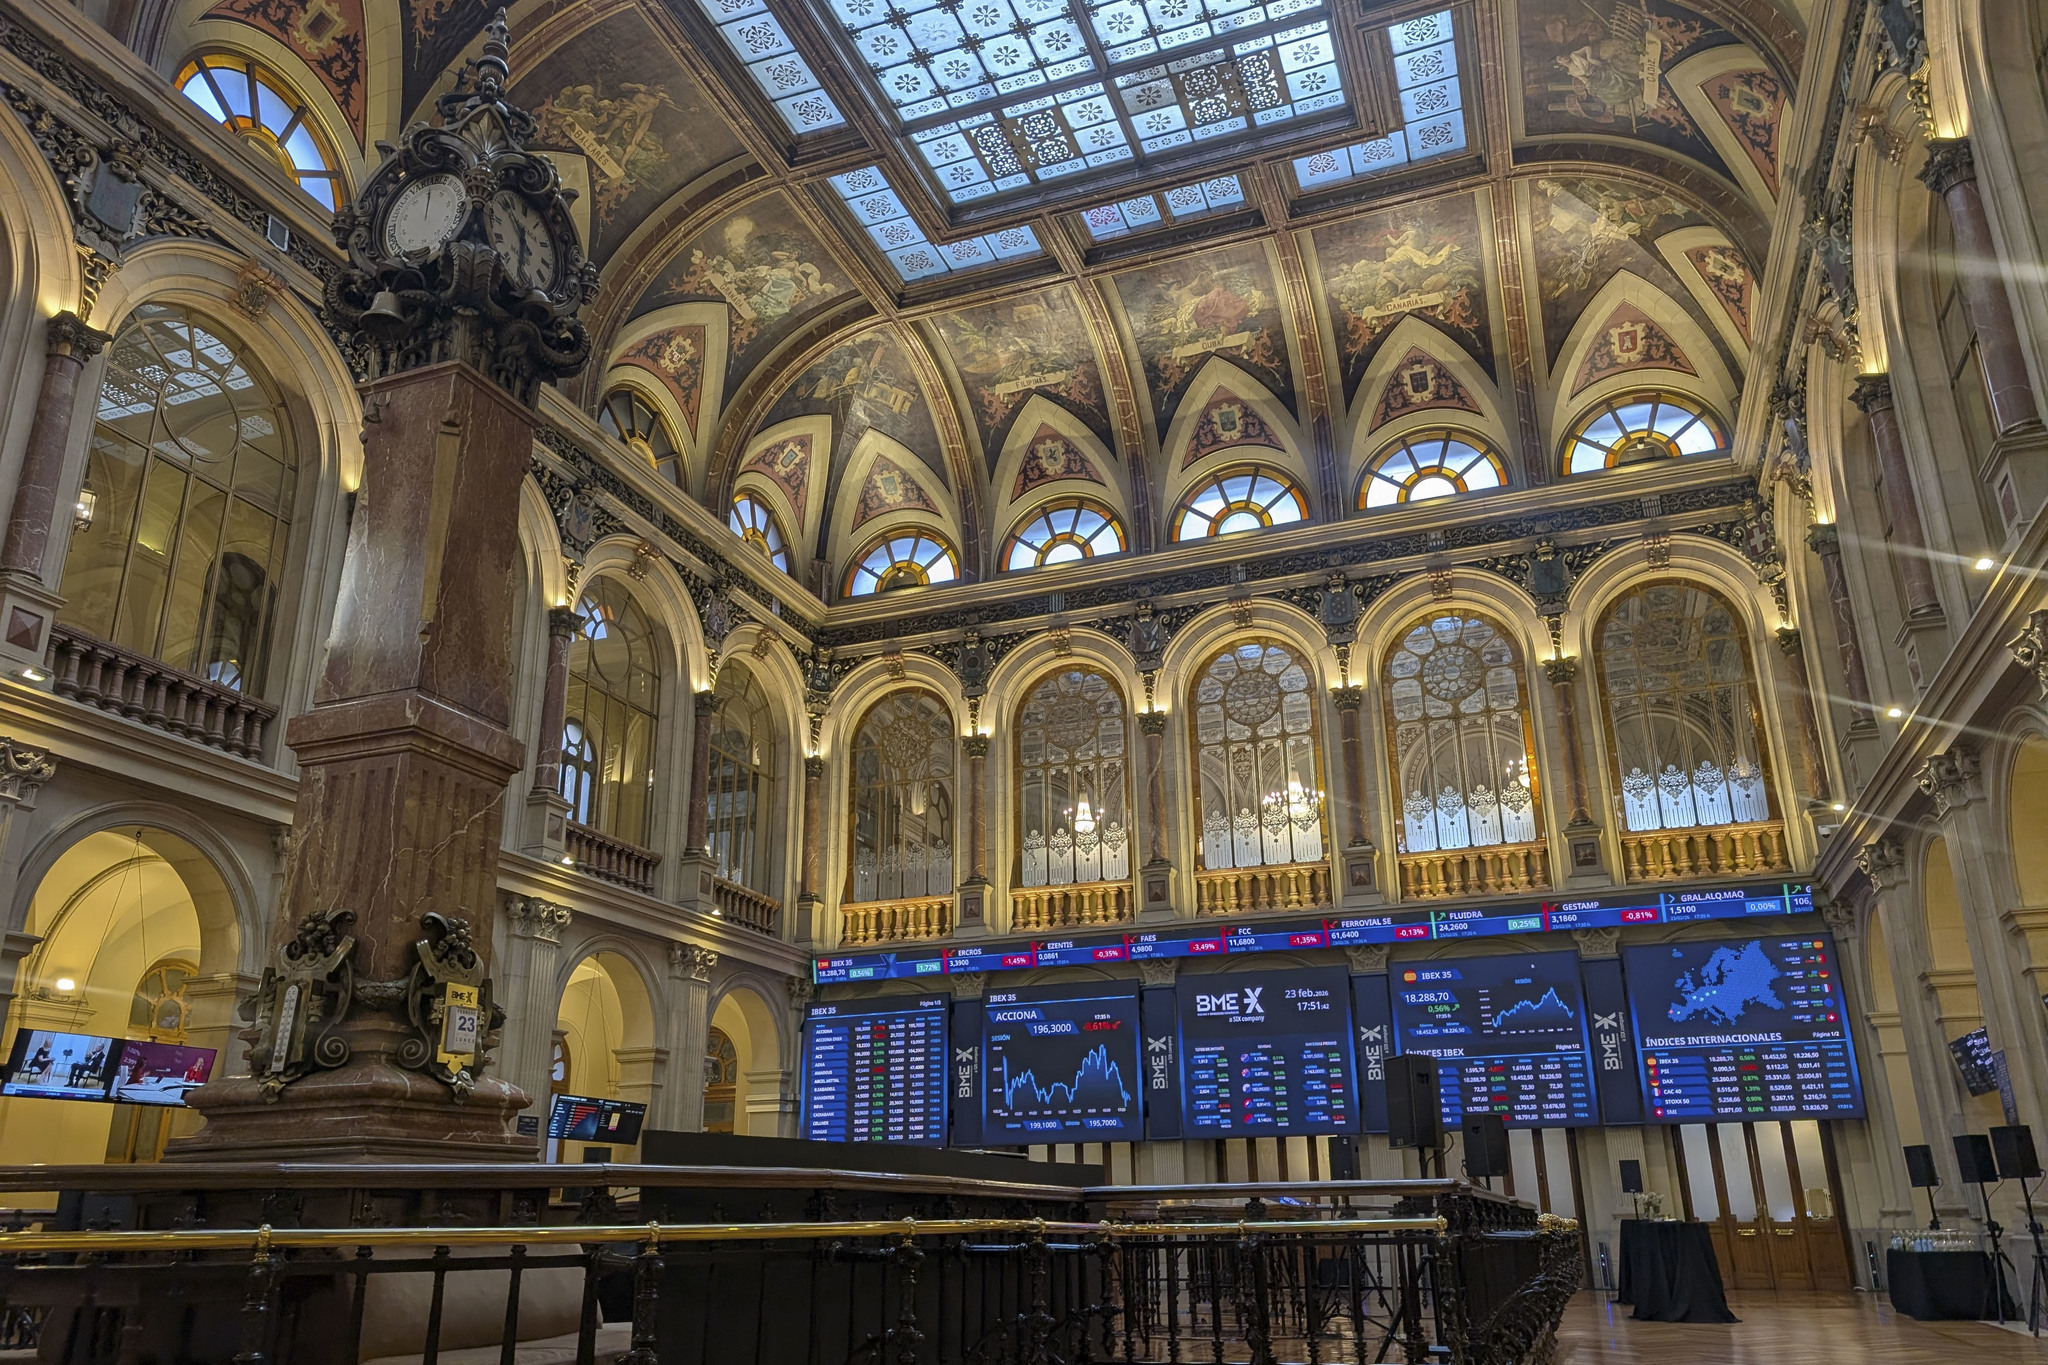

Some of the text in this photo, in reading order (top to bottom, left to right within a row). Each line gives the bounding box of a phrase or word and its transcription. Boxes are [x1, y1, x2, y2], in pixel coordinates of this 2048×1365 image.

[574, 131, 608, 165] BALEARES
[410, 176, 449, 195] VARIABLE
[1681, 891, 1744, 902] GRAL.ALQ.MAQ
[1563, 902, 1599, 911] GESTAMP
[1669, 902, 1775, 914] 1,5100 0,00%
[1449, 910, 1483, 920] FLUIDRA
[1551, 911, 1653, 923] 3,1860 -0,81%
[1341, 917, 1392, 928] FERROVIAL SE
[1439, 920, 1535, 932] 24,2600 0,25%
[1331, 928, 1424, 939] 61,6400 -0,13%
[1047, 941, 1073, 949] EZENTIS
[1229, 936, 1317, 946] 11,6800 -1,35%
[1131, 943, 1215, 953] 4,9800 -3,49%
[1038, 950, 1118, 961] 0,0861 -0,35%
[949, 957, 1026, 967] 3,3900 -1,45%
[1421, 971, 1452, 980] IBEX 35
[1285, 990, 1296, 998] 23
[1405, 992, 1449, 1003] 18.288,70
[1196, 993, 1239, 1012] BME
[811, 1007, 827, 1015] IBEX
[1428, 1005, 1450, 1013] 0,56%
[996, 1011, 1037, 1021] ACCIONA
[1242, 1015, 1265, 1023] company
[458, 1016, 475, 1033] 23
[1033, 1023, 1071, 1034] 196,3000
[1646, 1033, 1782, 1047] ÍNDICES INTERNACIONALES
[1443, 1048, 1464, 1056] IBEX
[1600, 1033, 1619, 1070] BME
[1365, 1045, 1382, 1080] BME
[1151, 1055, 1165, 1089] BME
[959, 1065, 970, 1098] BME
[1089, 1119, 1116, 1127] 195,7000
